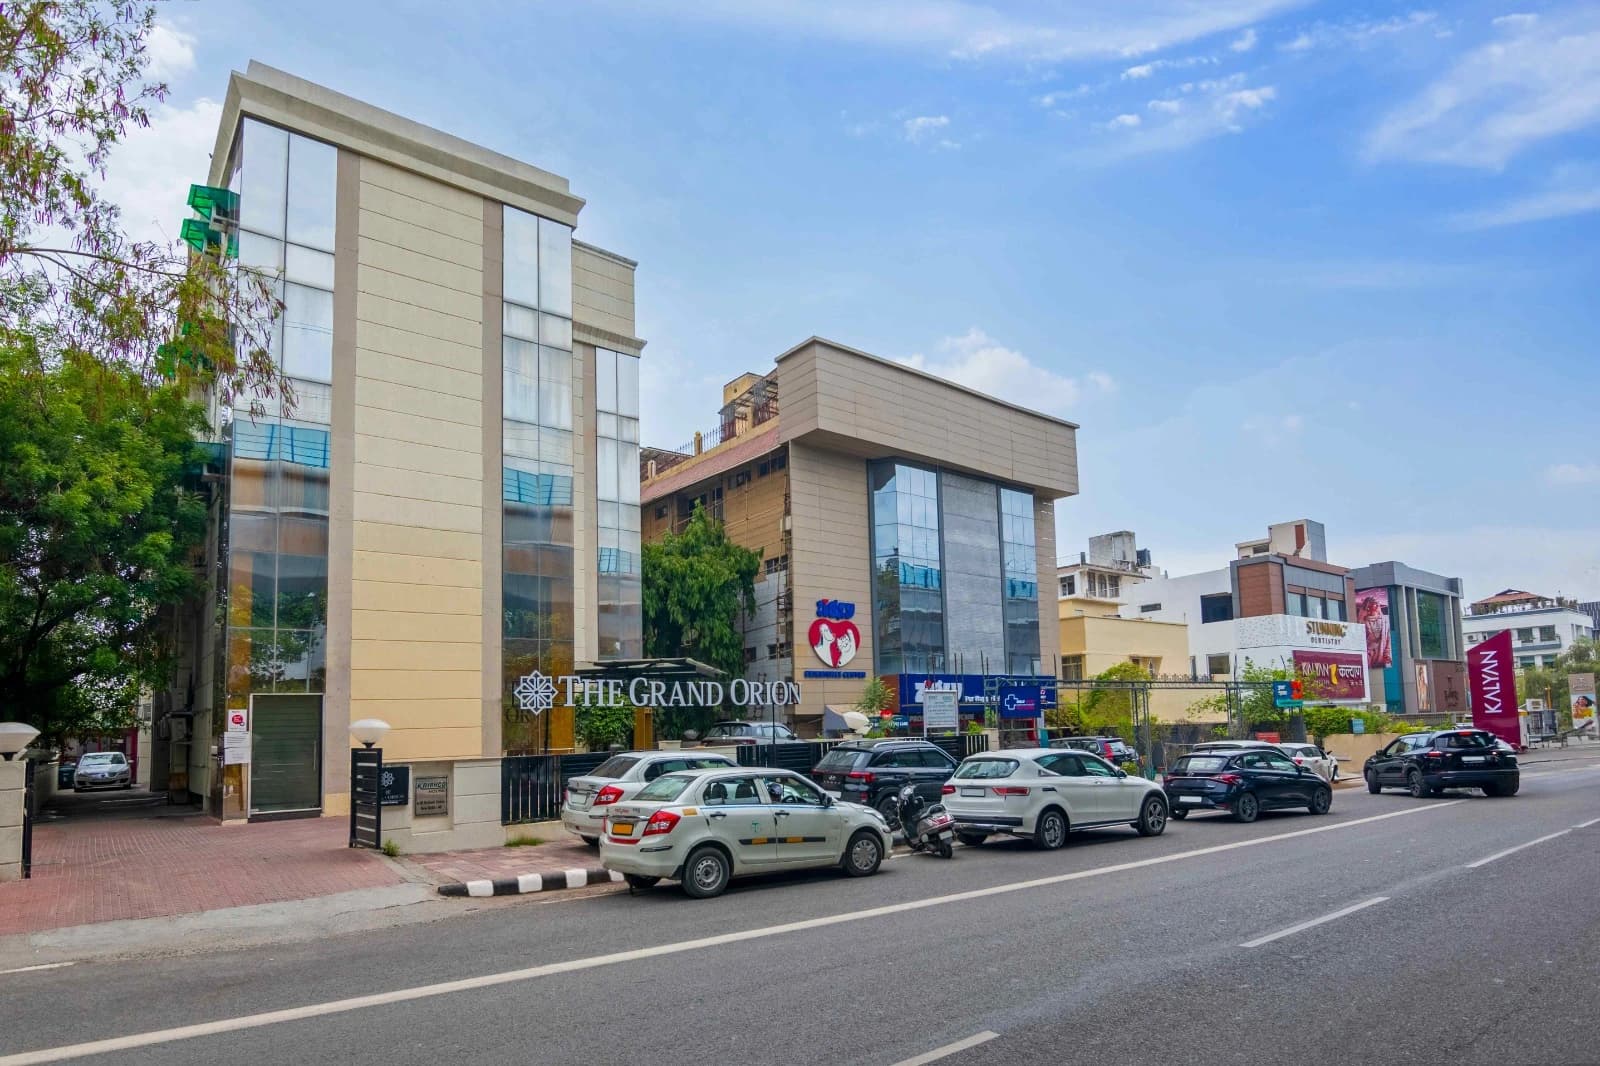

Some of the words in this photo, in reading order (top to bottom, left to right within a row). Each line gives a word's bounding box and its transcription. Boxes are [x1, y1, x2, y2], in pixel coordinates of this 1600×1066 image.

[558, 675, 624, 707] THE
[629, 677, 724, 707] GRAND
[730, 678, 803, 706] ORION
[1479, 650, 1503, 714] KALYAN
